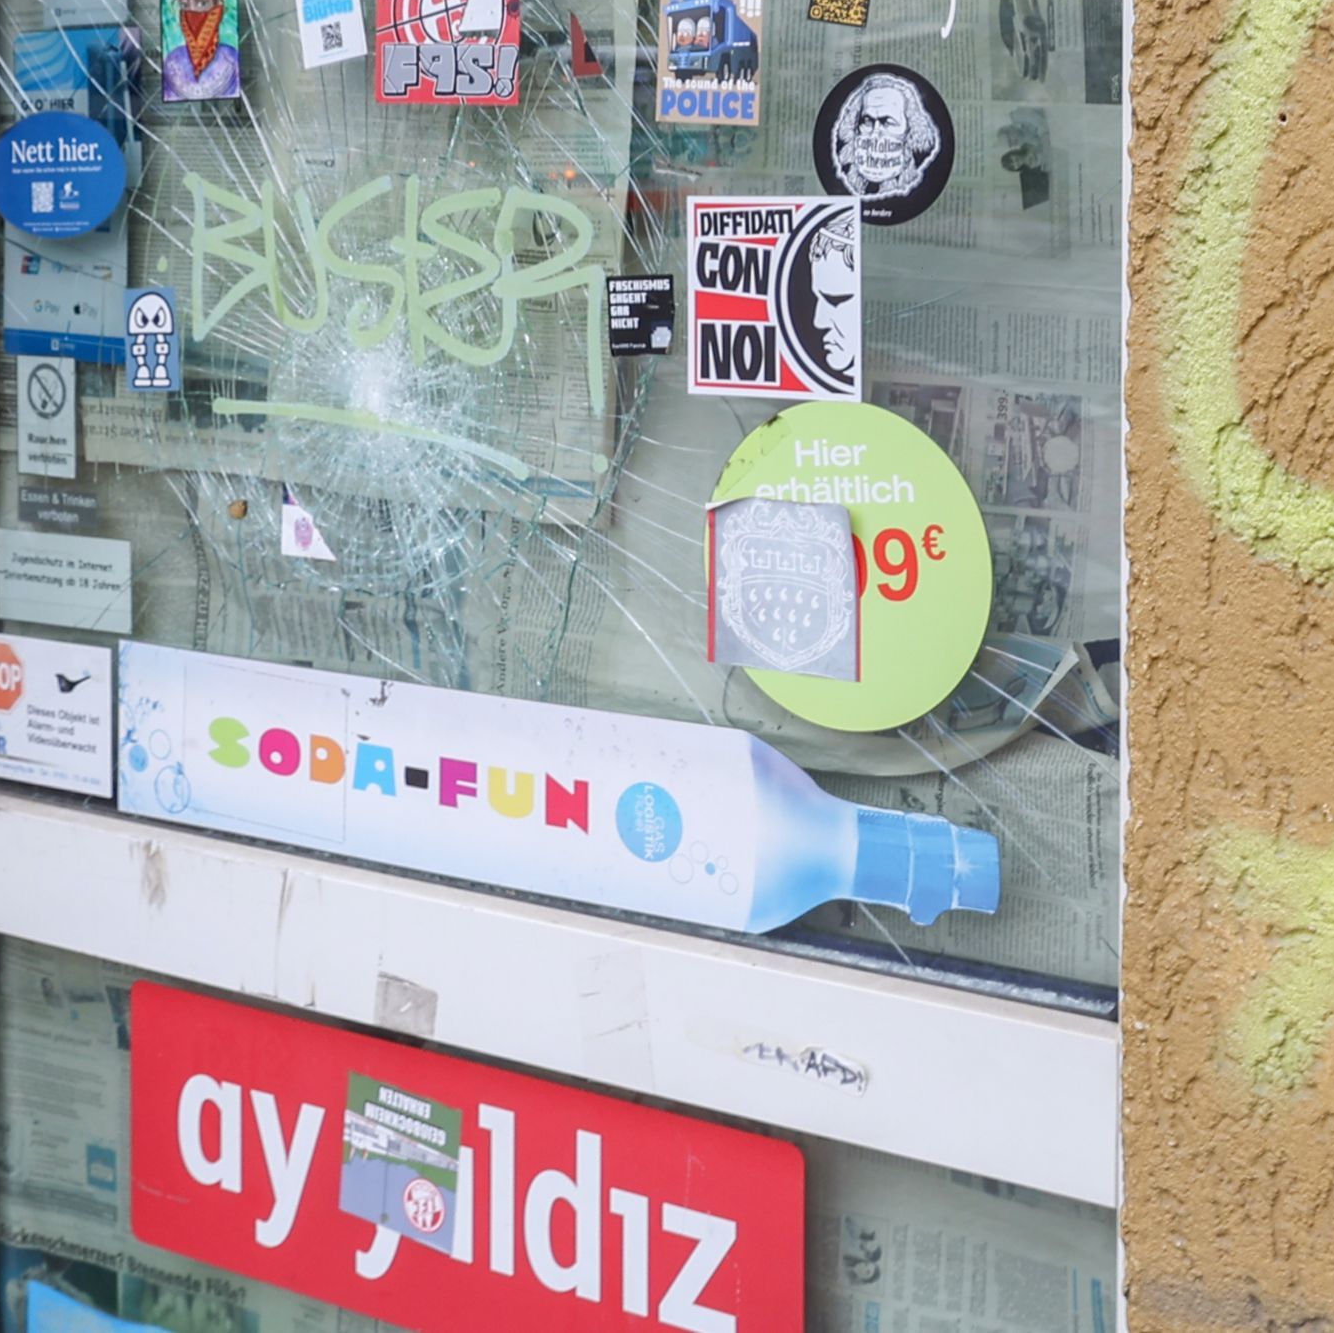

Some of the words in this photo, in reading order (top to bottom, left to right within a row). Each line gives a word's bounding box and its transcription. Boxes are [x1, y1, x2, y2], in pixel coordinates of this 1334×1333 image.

[663, 76, 683, 89] The
[685, 77, 718, 90] sound
[720, 77, 734, 90] of
[737, 78, 756, 91] the
[660, 89, 756, 120] POLICE
[11, 139, 55, 164] Nett
[58, 137, 103, 163] hier.
[700, 209, 793, 236] DIFFIDATI
[696, 241, 770, 295] CON
[609, 278, 670, 292] FASCHISMUS
[610, 305, 630, 317] GAR
[611, 317, 639, 329] NICHT
[700, 323, 778, 383] NOI
[27, 432, 67, 446] Rauchen
[27, 452, 68, 466] verboten
[794, 439, 867, 468] Hier
[20, 488, 50, 503] Essen
[51, 491, 60, 504] &
[61, 492, 98, 508] Trinken
[755, 473, 916, 506] erhältlich
[37, 509, 80, 523] verboten
[27, 704, 56, 719] Dieses
[59, 709, 87, 725] Objekt
[89, 715, 100, 726] ist
[27, 719, 56, 732] Alarm-
[58, 725, 75, 736] und
[27, 733, 98, 754] Videoüberwacht
[208, 716, 589, 834] SODA-FUN
[177, 1074, 327, 1249] ay
